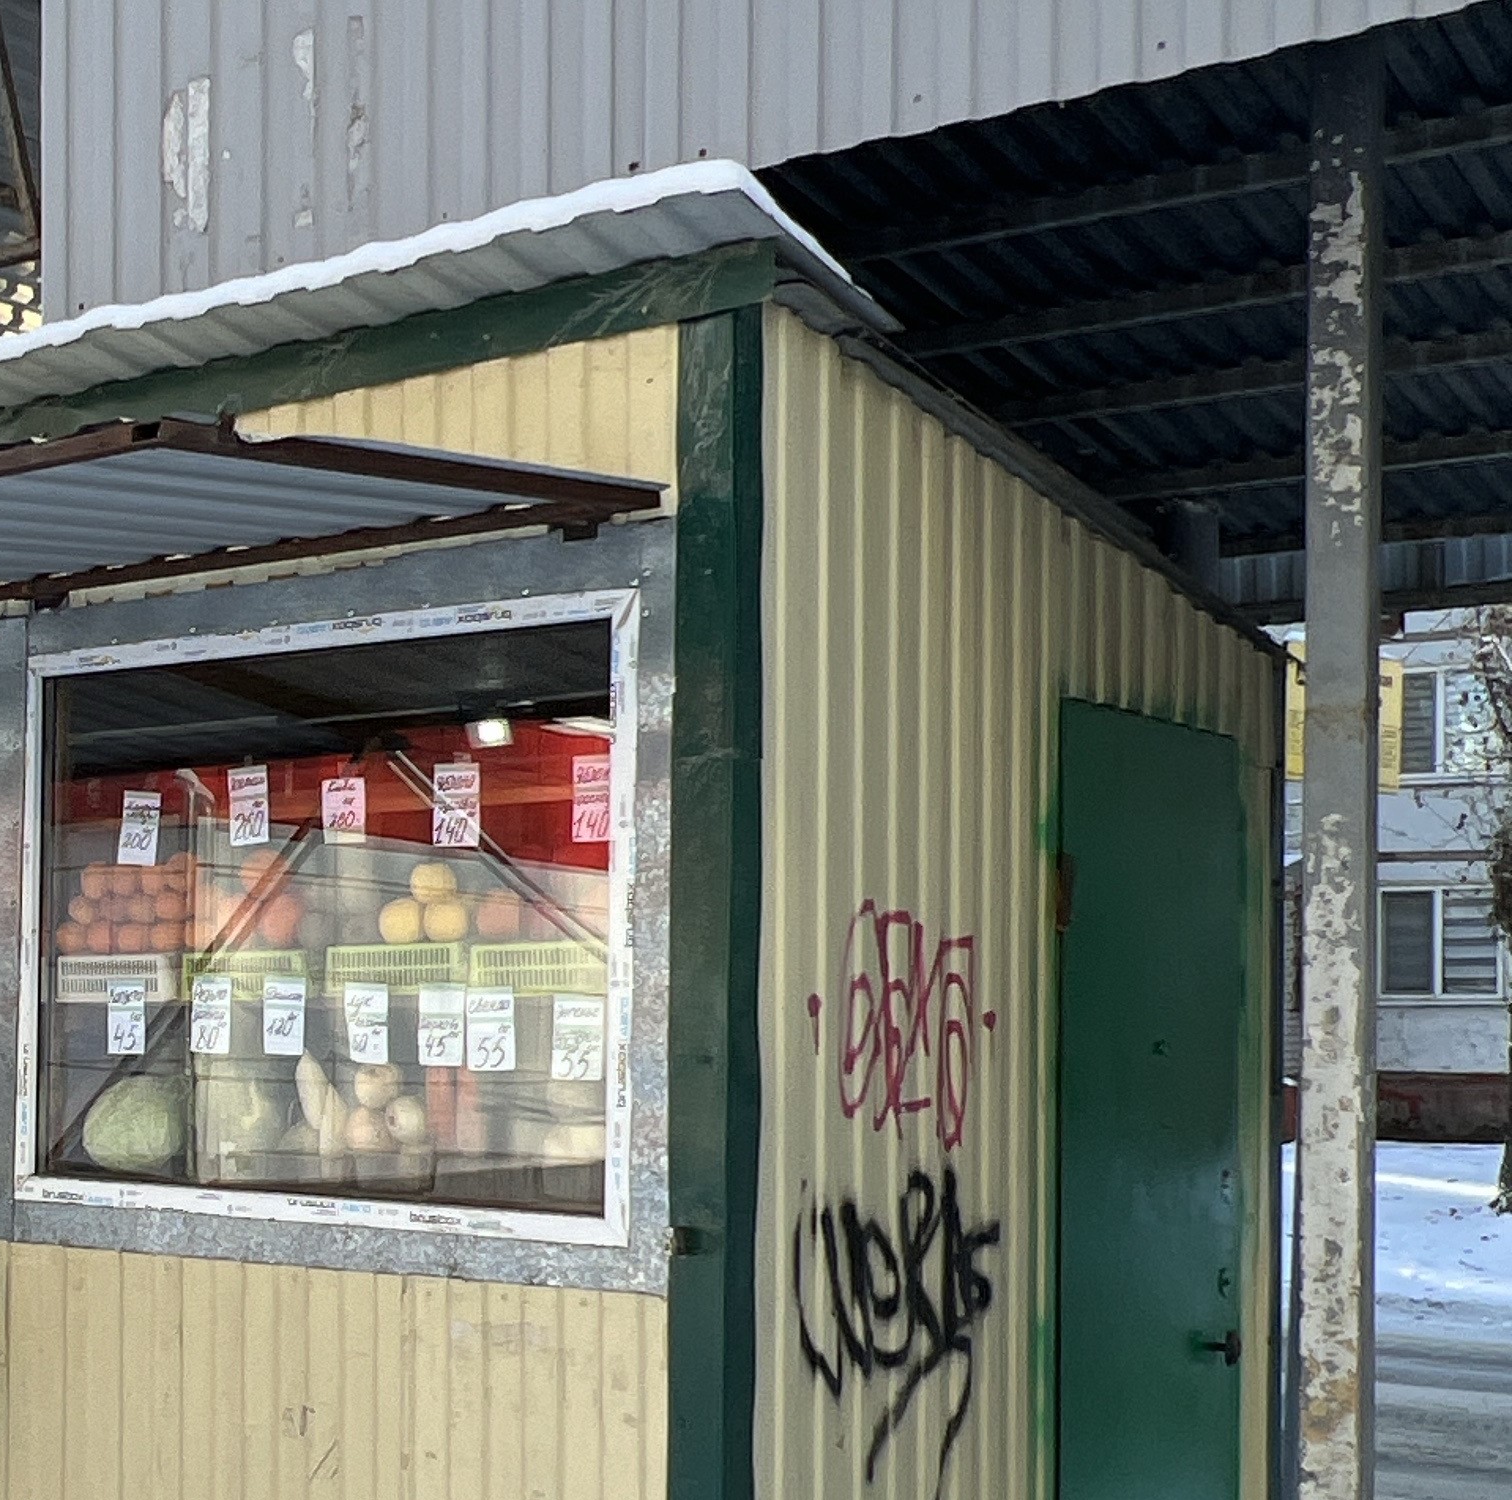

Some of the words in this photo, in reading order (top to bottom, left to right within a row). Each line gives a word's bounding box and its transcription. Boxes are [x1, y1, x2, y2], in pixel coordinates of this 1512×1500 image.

[113, 1023, 139, 1052] 45
[425, 1031, 448, 1057] 45
[474, 1036, 507, 1068] 55
[558, 1050, 589, 1080] 55
